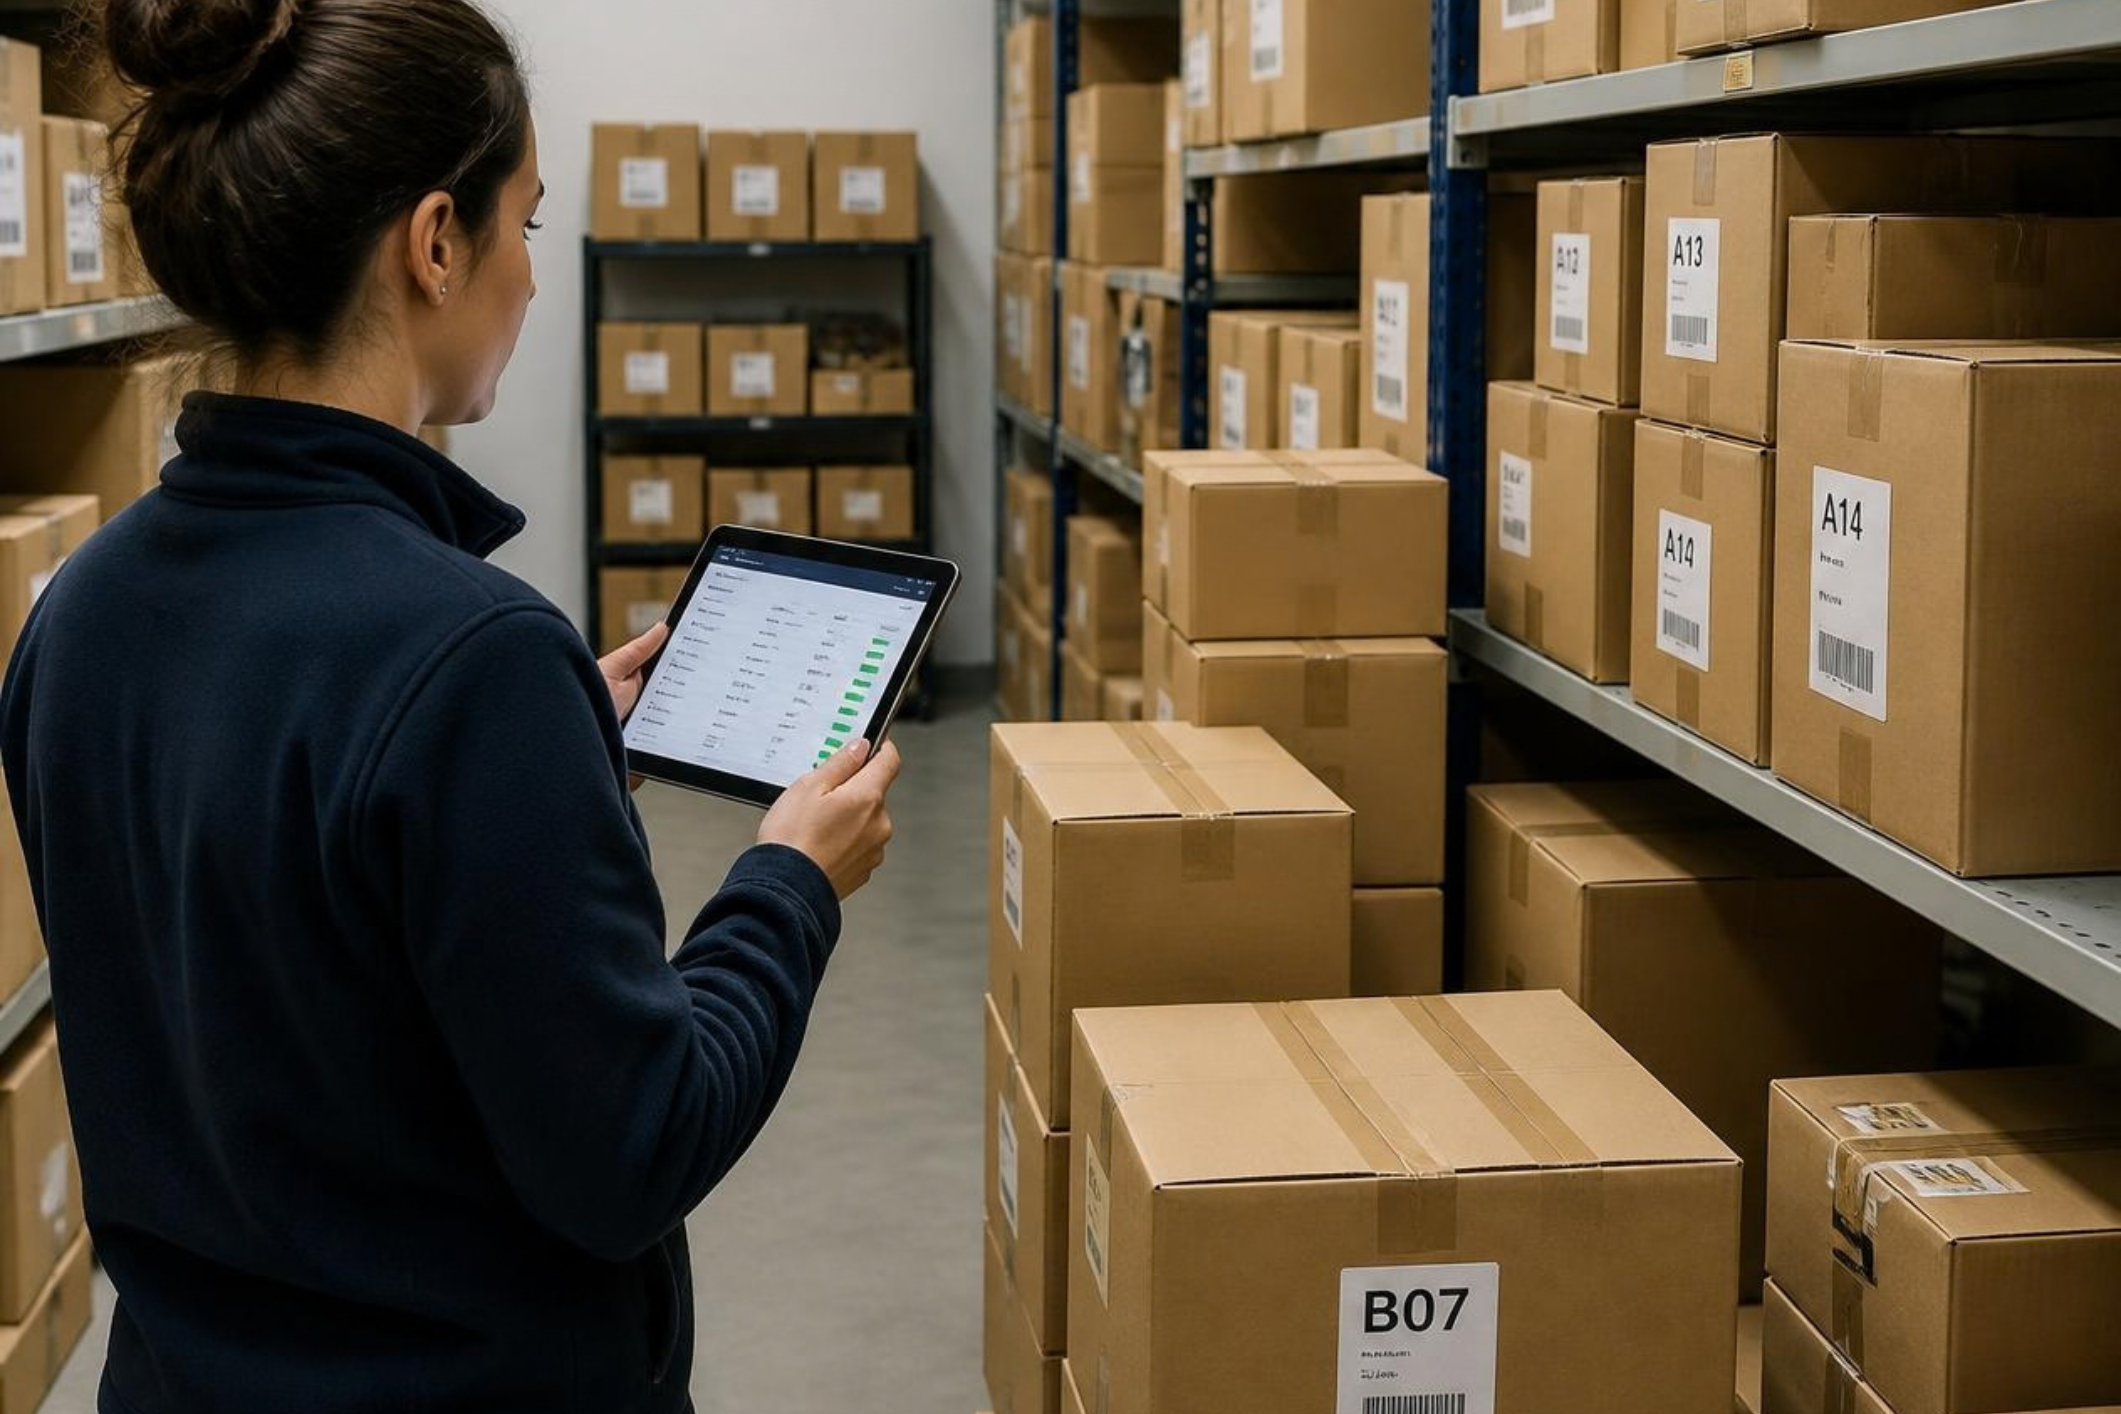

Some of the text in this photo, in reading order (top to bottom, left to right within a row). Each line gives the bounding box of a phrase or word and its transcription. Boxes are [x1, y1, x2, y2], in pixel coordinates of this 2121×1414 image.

[1672, 235, 1704, 267] A13
[1821, 492, 1863, 541] A14
[1664, 527, 1695, 568] A14
[1364, 1288, 1469, 1333] B07
